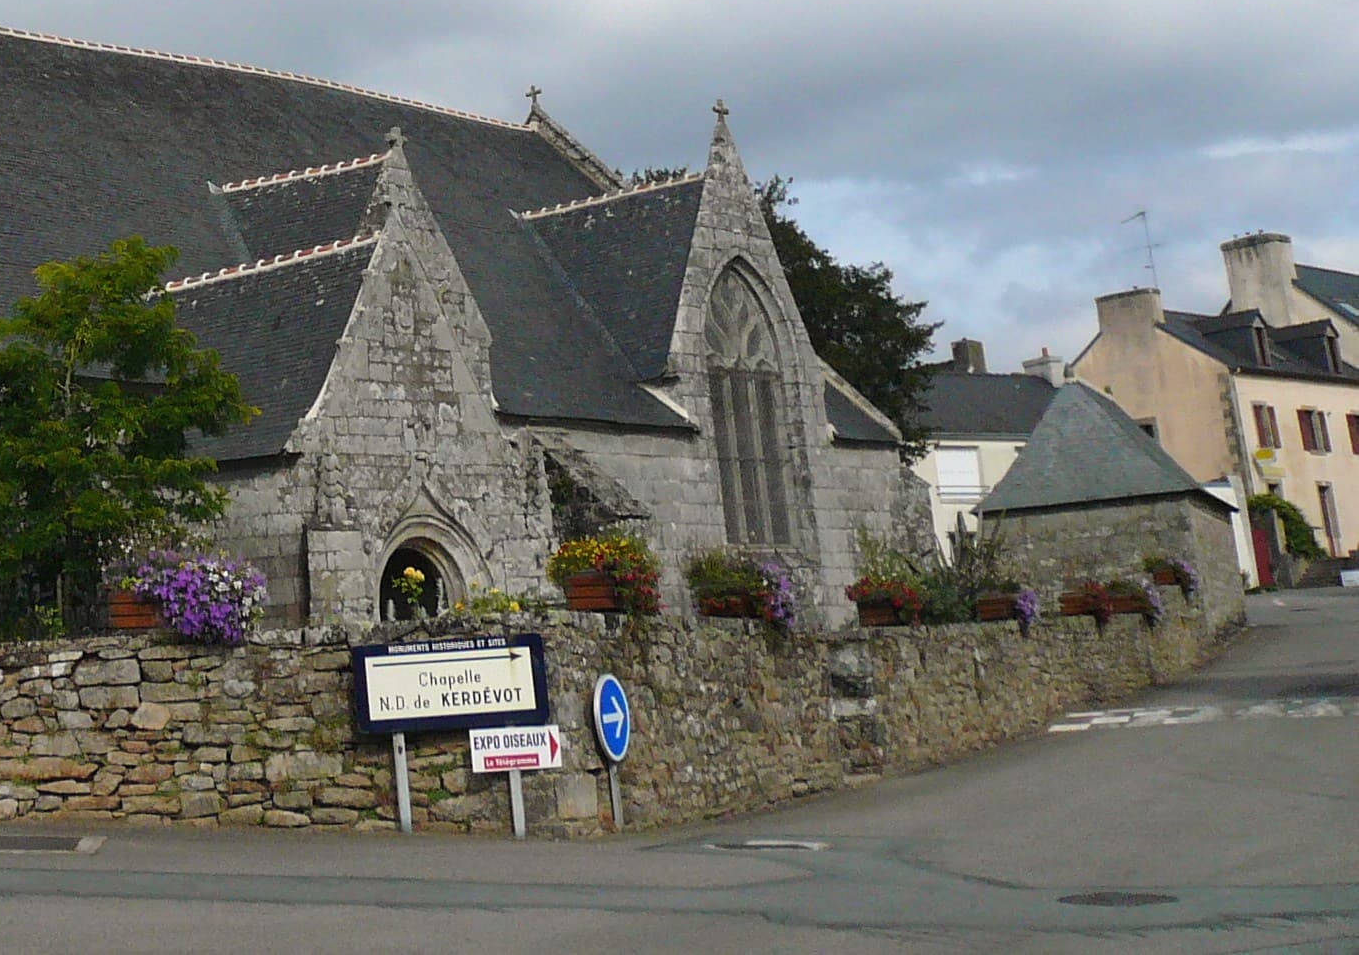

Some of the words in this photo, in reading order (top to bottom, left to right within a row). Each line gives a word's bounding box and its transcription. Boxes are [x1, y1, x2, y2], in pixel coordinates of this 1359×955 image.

[388, 643, 430, 654] MONUMENTS
[432, 640, 474, 651] HISTORIQUES
[477, 639, 485, 648] ET
[488, 638, 506, 647] SITES
[419, 669, 481, 690] Chapelle
[379, 695, 409, 712] N.D.
[414, 694, 430, 709] de
[473, 735, 501, 751] EXPO
[503, 732, 547, 749] OISEAUX
[486, 758, 495, 767] Le
